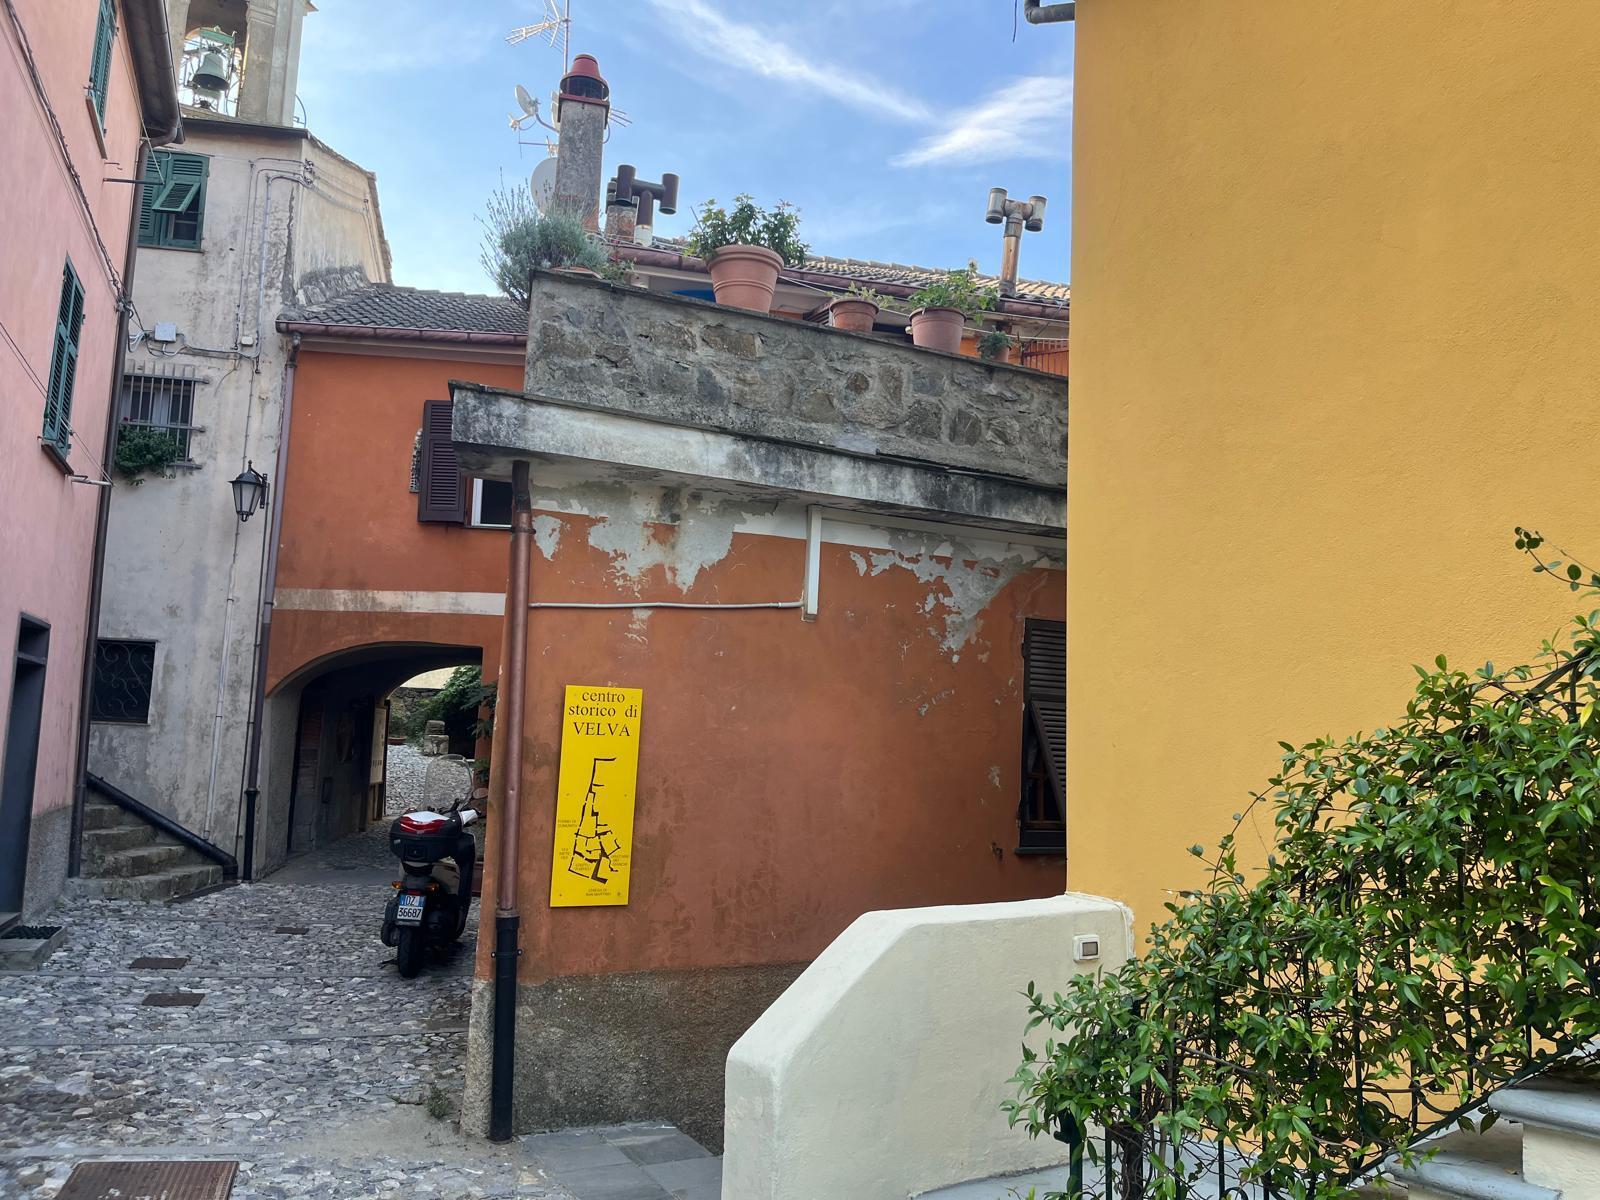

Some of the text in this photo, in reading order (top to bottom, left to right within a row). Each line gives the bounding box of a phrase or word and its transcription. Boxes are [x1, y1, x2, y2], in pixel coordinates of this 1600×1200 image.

[582, 691, 625, 703] centro
[568, 703, 638, 718] storico di
[573, 721, 630, 736] VELVA
